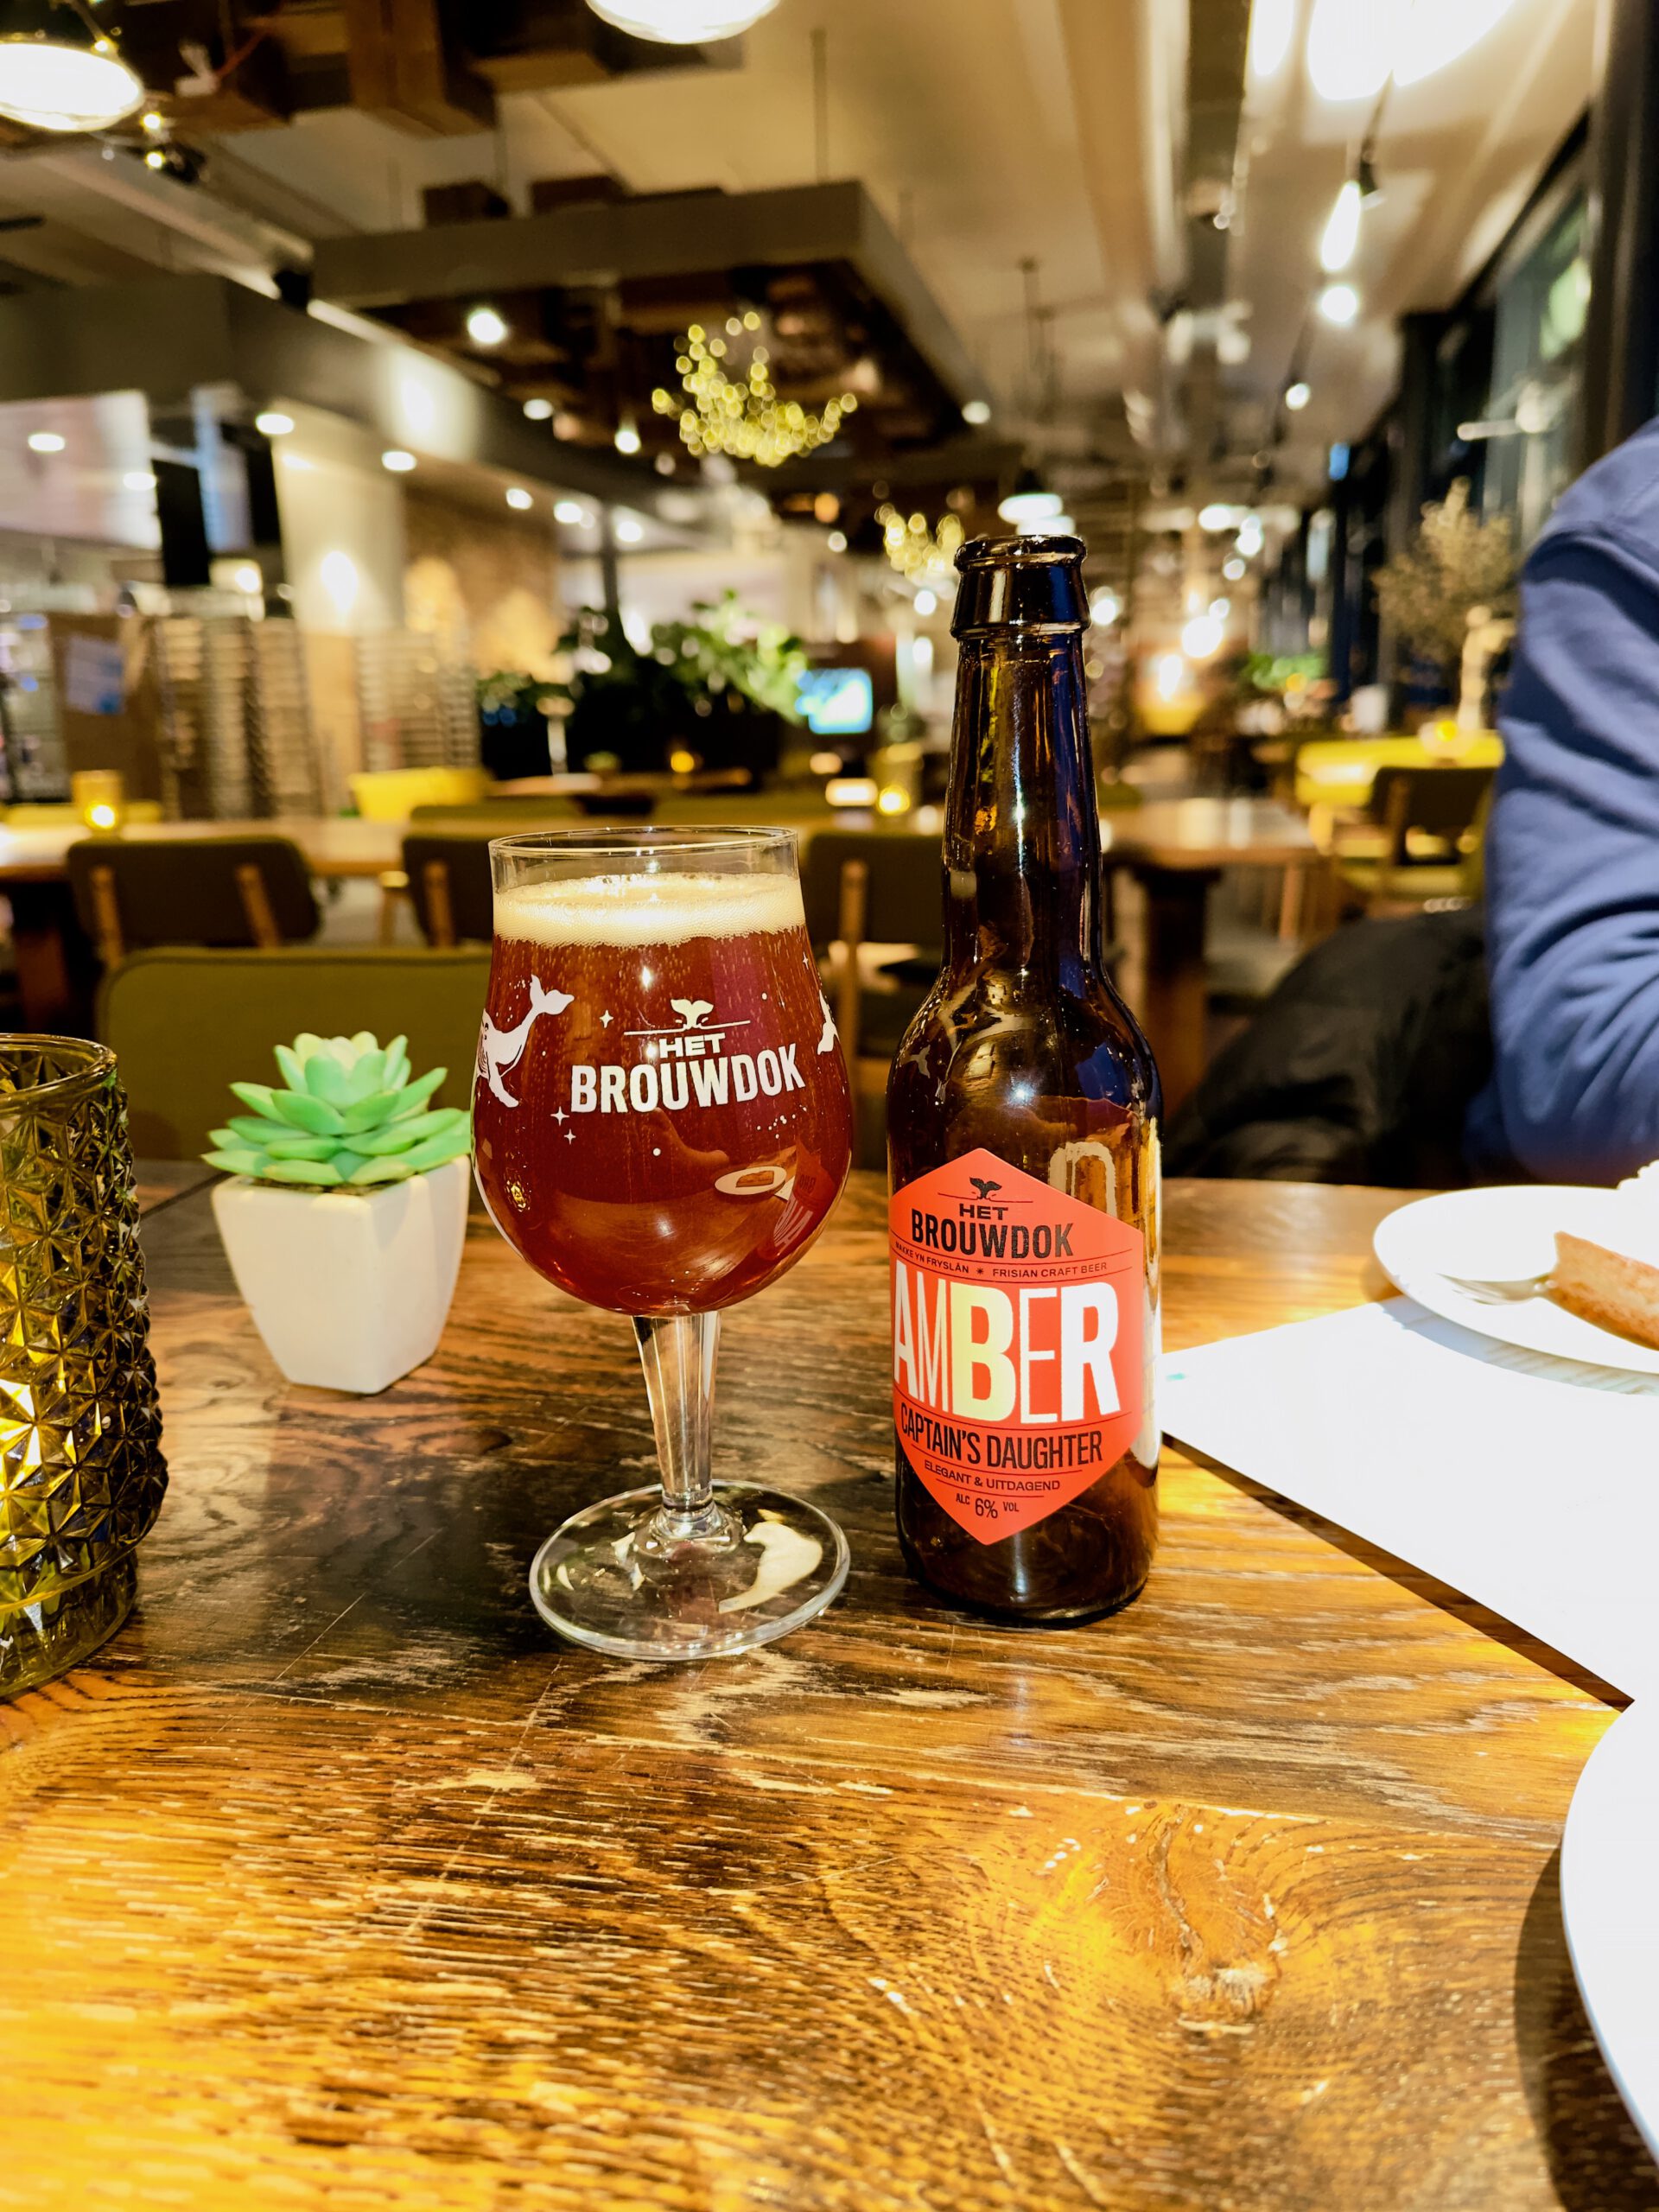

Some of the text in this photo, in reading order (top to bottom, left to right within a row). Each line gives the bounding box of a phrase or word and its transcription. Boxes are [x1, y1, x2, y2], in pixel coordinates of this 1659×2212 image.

[658, 1033, 726, 1058] HET
[571, 1043, 805, 1114] BROUWDOK
[959, 1203, 1008, 1220] HET
[912, 1208, 1074, 1258] BROUWDOK
[915, 1252, 925, 1262] YN
[993, 1268, 1038, 1278] FRISIAN
[1040, 1267, 1077, 1277] CRAFT
[1081, 1262, 1107, 1274] BEER
[894, 1260, 1121, 1424] AMBER
[900, 1402, 1103, 1470] CAPTAIN'S DAUGHTER
[925, 1461, 1060, 1491] ELEGANT & UITDAGEND
[956, 1493, 1020, 1518] ALC 6% VOL
